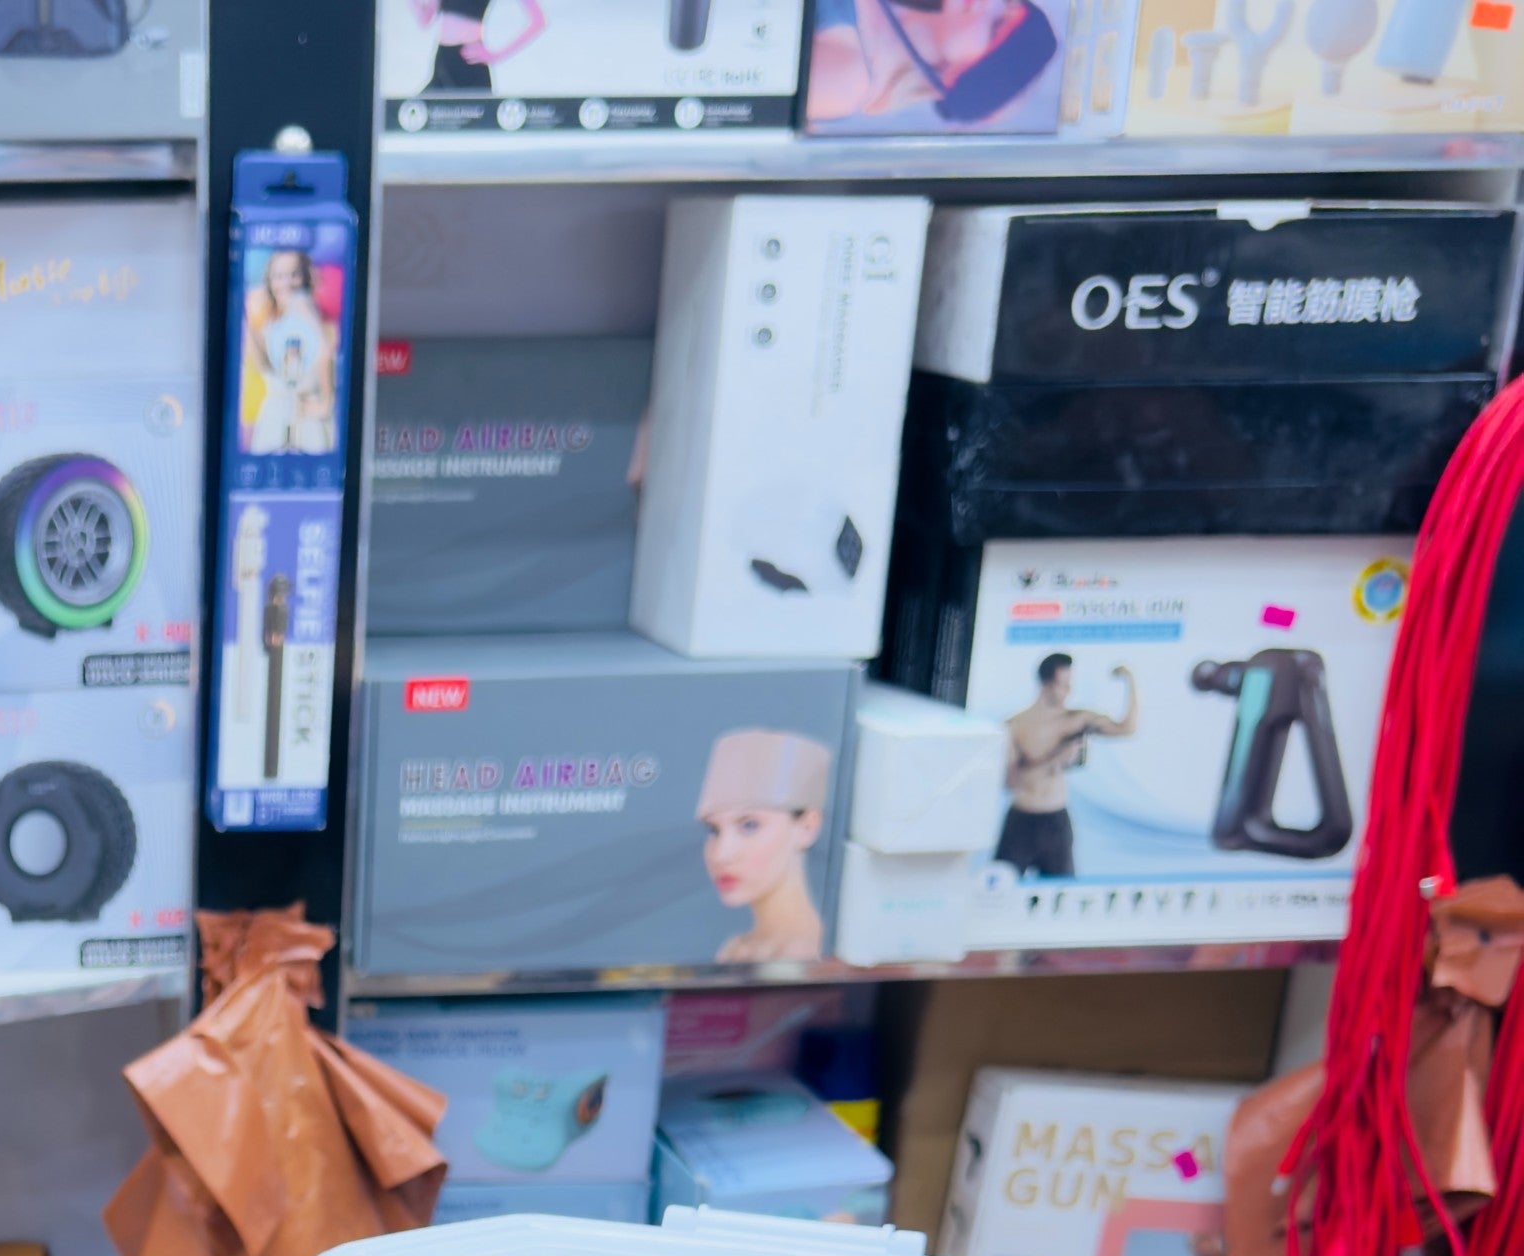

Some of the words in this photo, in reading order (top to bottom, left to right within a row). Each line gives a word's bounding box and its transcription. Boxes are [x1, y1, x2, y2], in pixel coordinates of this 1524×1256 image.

[1071, 274, 1199, 330] OES
[1227, 276, 1421, 325] 智能筋膜枪
[376, 348, 409, 373] EW
[376, 424, 442, 453] EAD
[453, 423, 593, 452] AIRBAG
[440, 454, 562, 477] INSTRUMENT
[293, 521, 325, 640] SELFIE
[294, 650, 318, 744] STICK
[412, 684, 465, 709] NEW
[402, 761, 500, 792] HEAD
[514, 755, 658, 789] AIRBAG
[499, 789, 625, 816] INSTRUMENT
[1013, 1122, 1215, 1174] MASSA
[1004, 1167, 1129, 1213] GUN
